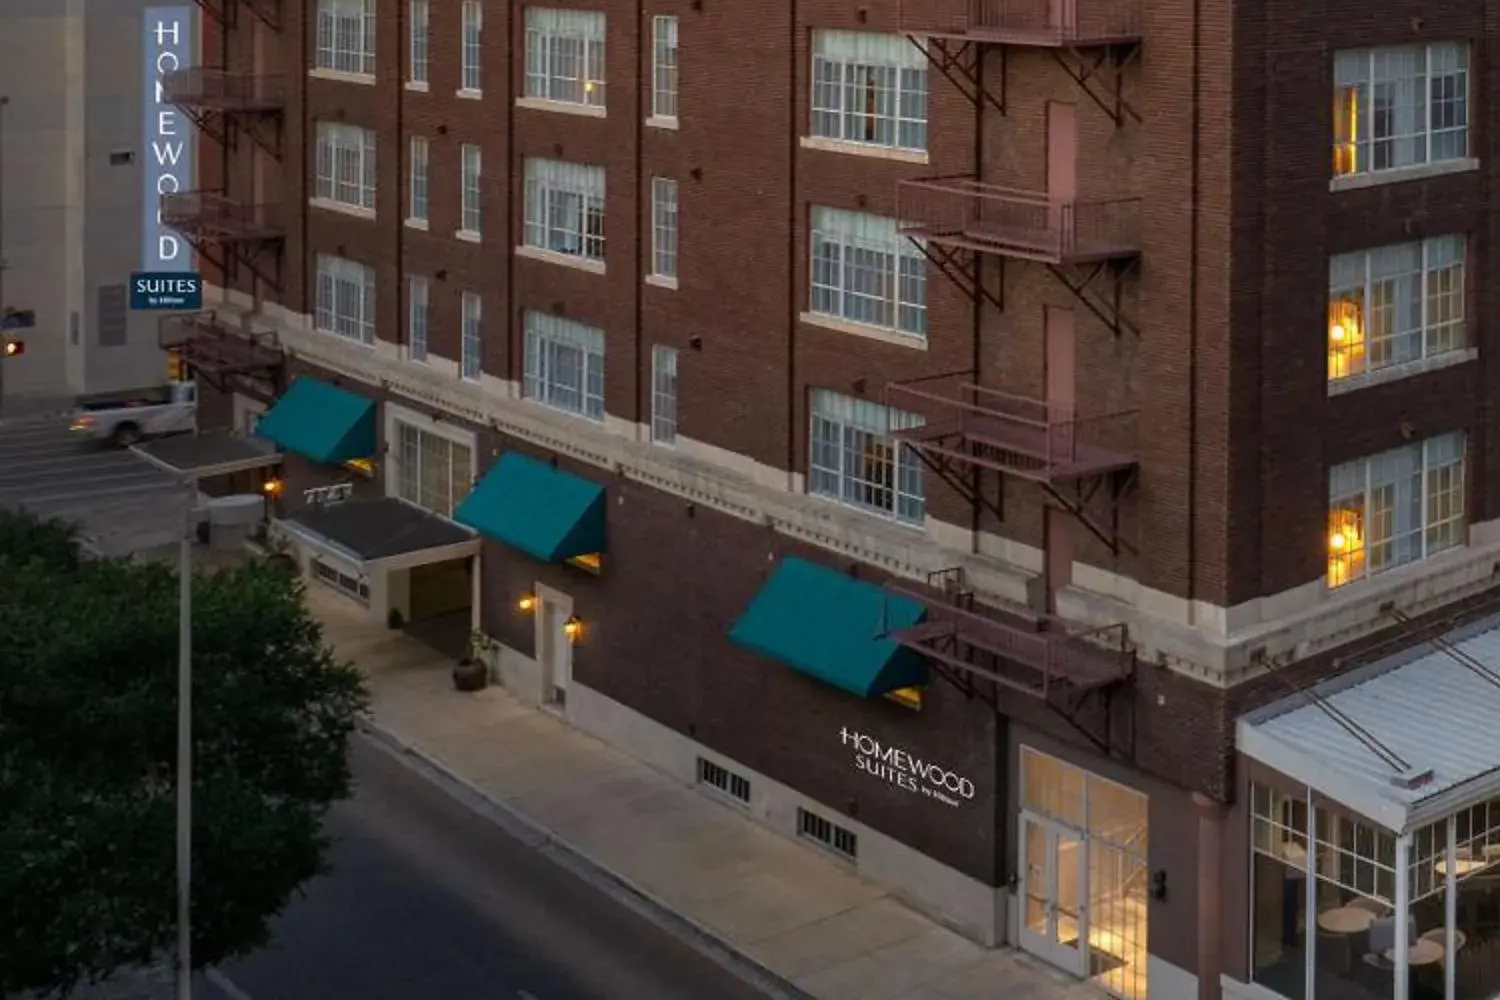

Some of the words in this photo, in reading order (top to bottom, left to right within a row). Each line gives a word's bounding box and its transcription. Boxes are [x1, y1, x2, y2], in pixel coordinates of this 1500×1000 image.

[153, 21, 183, 260] HOEWOD
[136, 279, 196, 293] SUITES
[838, 726, 975, 799] HOMEWOOD
[855, 754, 918, 792] SUITES
